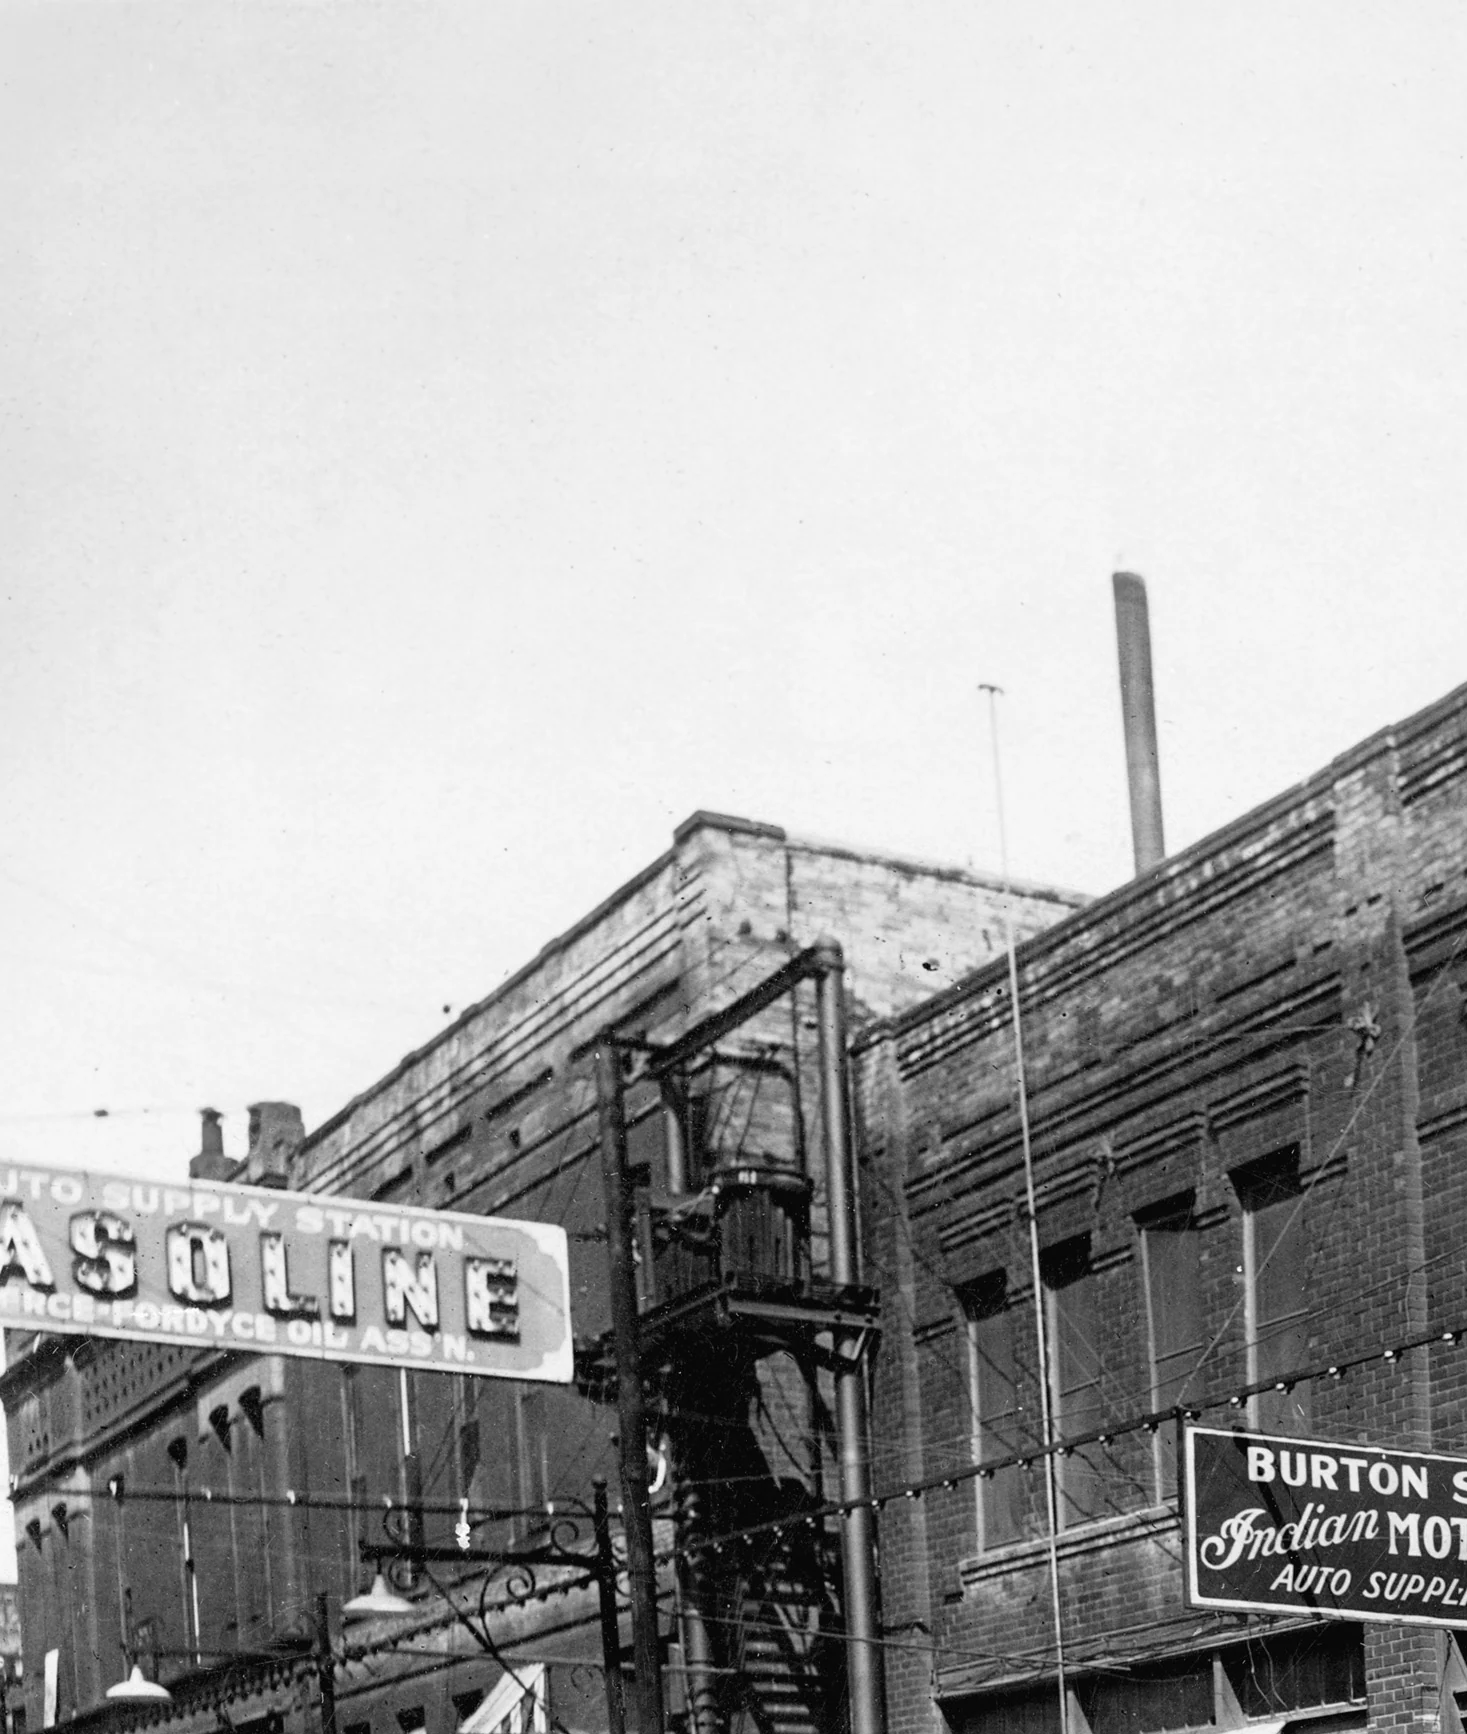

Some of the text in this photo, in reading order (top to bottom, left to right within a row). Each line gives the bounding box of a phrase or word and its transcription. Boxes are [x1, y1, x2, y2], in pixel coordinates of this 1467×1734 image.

[102, 1181, 279, 1229] SUPPLY
[296, 1206, 464, 1250] STATION
[287, 1319, 349, 1349] OIL
[1247, 1446, 1429, 1500] BURTON
[1200, 1502, 1380, 1571] Indian
[1270, 1564, 1352, 1597] AUTO
